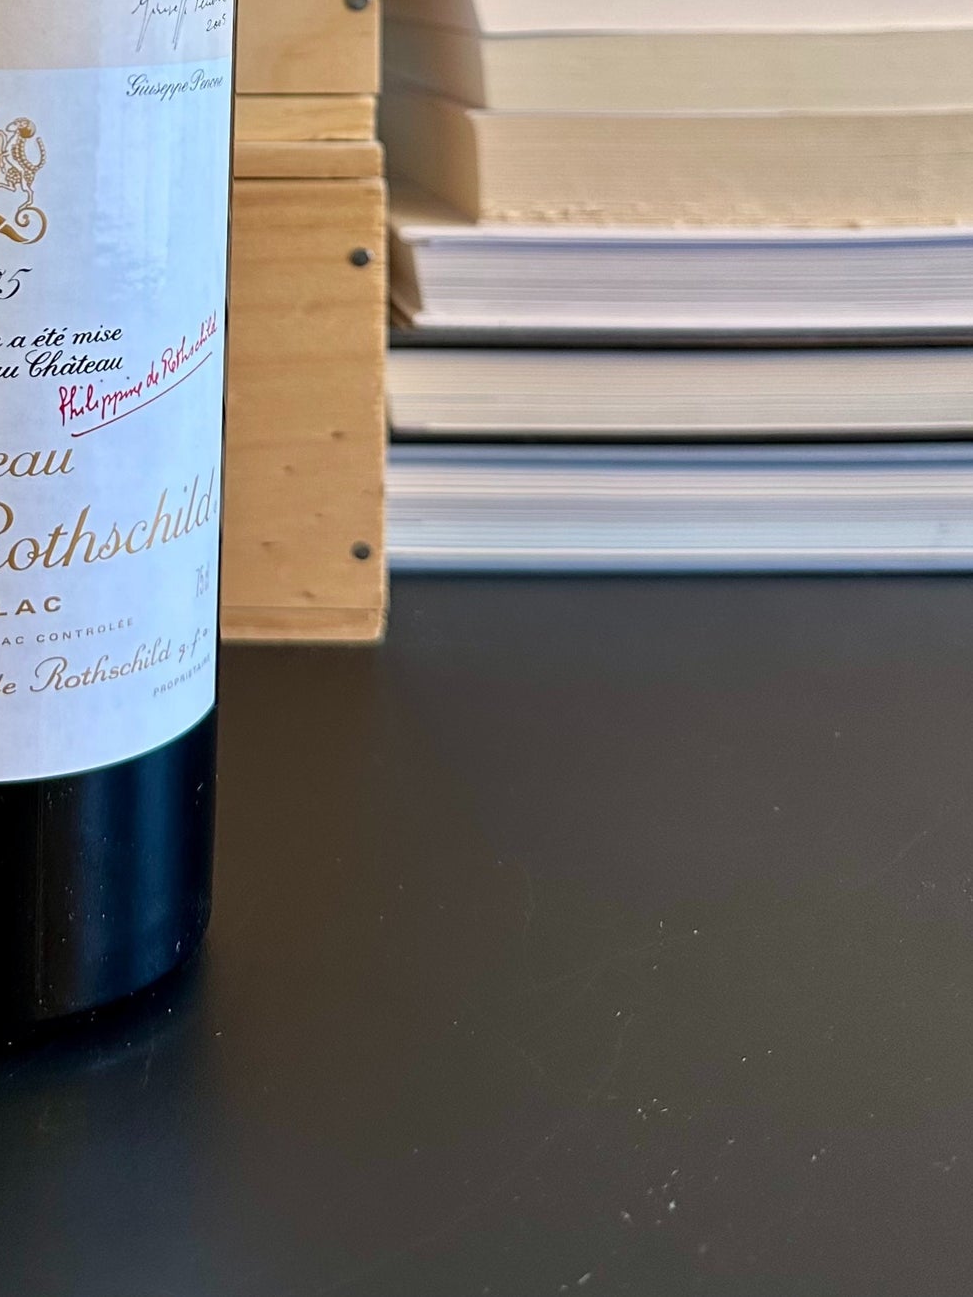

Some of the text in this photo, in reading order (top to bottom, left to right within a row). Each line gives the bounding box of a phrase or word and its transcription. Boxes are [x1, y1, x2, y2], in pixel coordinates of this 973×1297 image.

[126, 74, 188, 101] Giuseppe
[7, 333, 27, 349] a
[31, 327, 65, 348] été
[72, 325, 123, 345] mise
[25, 349, 124, 379] Château
[59, 309, 218, 427] Philippine de Rothschild
[36, 616, 134, 643] CONTROLÉE
[29, 637, 172, 693] Rothschild
